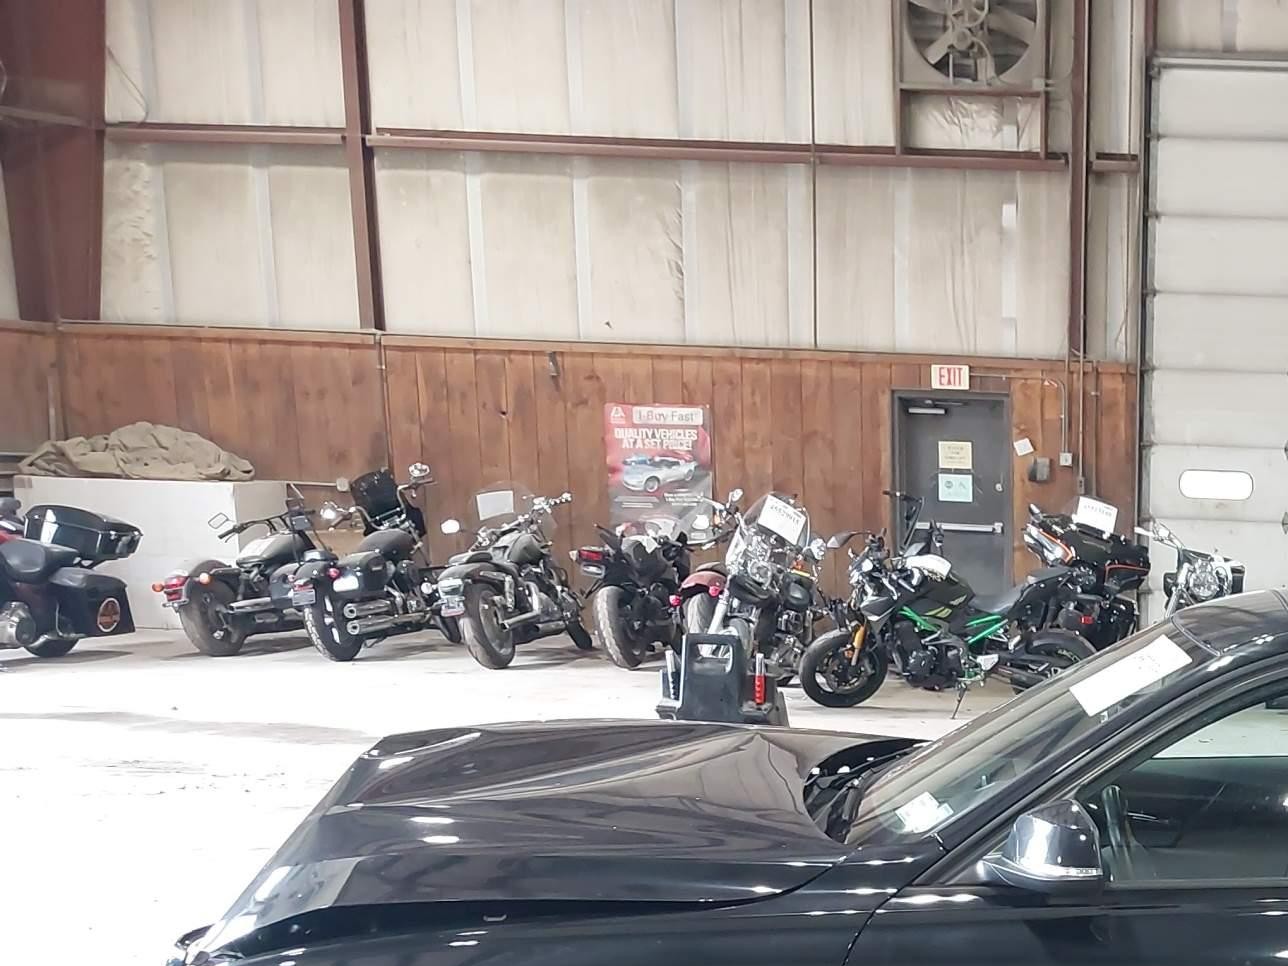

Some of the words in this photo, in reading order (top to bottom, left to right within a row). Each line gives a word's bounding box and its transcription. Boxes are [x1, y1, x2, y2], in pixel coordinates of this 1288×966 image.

[939, 367, 963, 386] EXIT
[671, 410, 695, 423] Fast
[614, 427, 653, 439] QUALITY
[654, 428, 698, 440] VEHICLES
[622, 438, 635, 449] AT
[644, 439, 662, 449] SET
